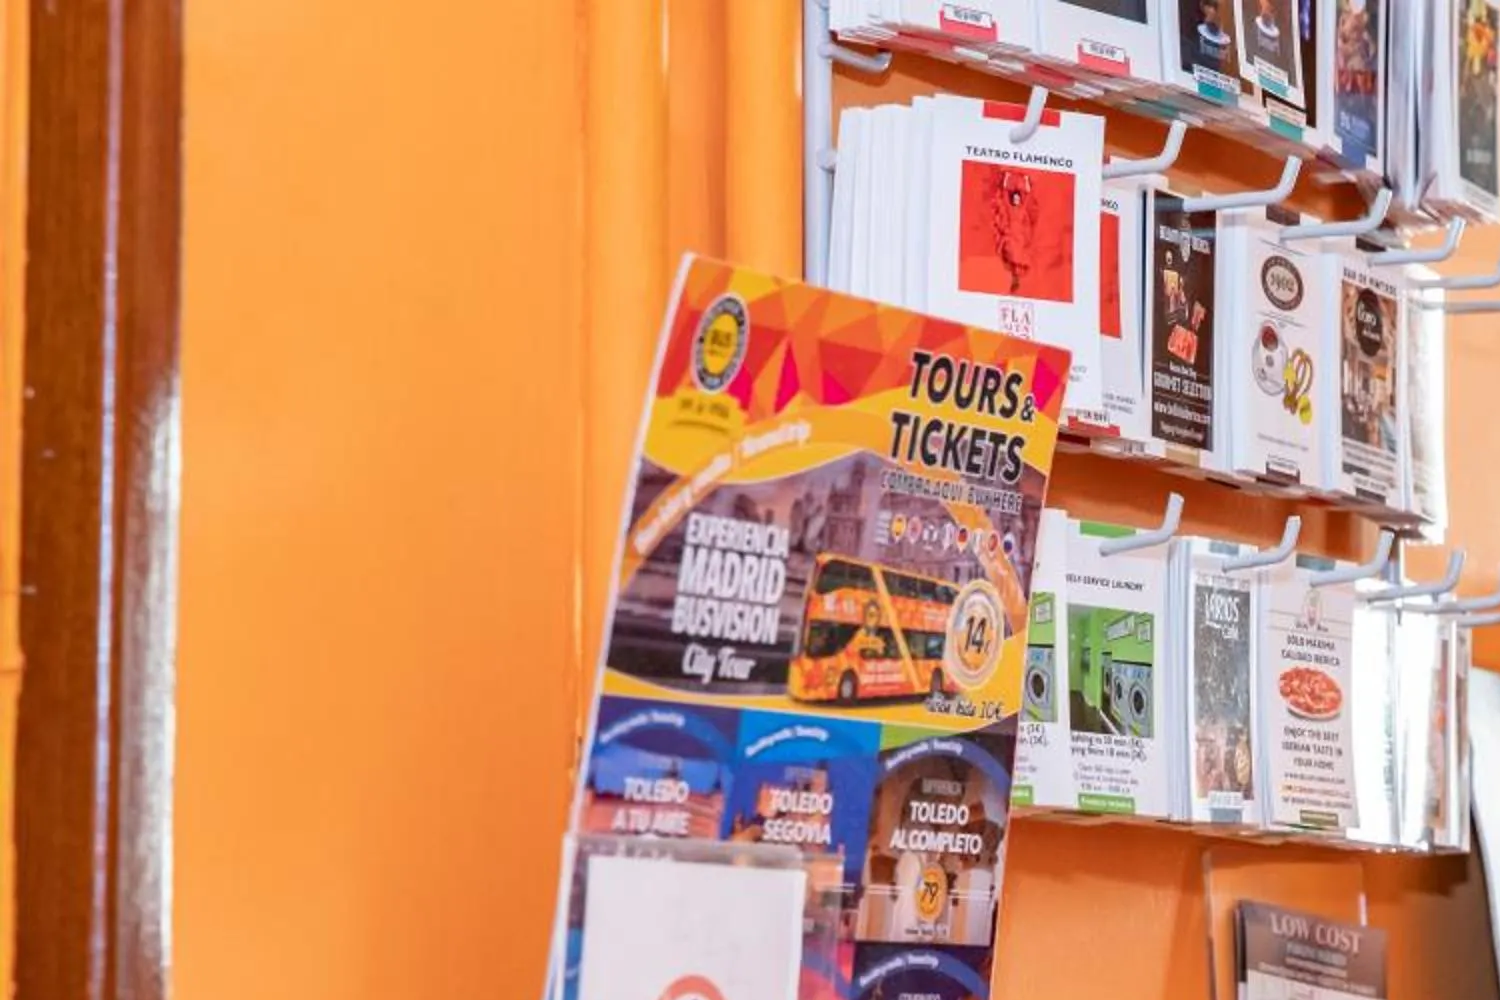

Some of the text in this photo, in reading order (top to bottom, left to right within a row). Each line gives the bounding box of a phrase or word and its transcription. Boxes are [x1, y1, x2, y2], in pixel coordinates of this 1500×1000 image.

[966, 145, 1074, 169] TEATRO FLAMENCO
[911, 352, 1035, 423] TOURS &
[892, 411, 1025, 482] TICKETS
[678, 546, 787, 605] MADRID
[671, 594, 781, 645] BUSVISION
[682, 642, 756, 685] City Tour
[624, 776, 690, 804] TOLEDO
[768, 787, 833, 815] TOLEDO
[762, 817, 832, 845] SEGOVIA
[909, 801, 970, 826] TOLEDO
[908, 831, 983, 855] COMPLETO
[1270, 911, 1363, 954] LOW COST
